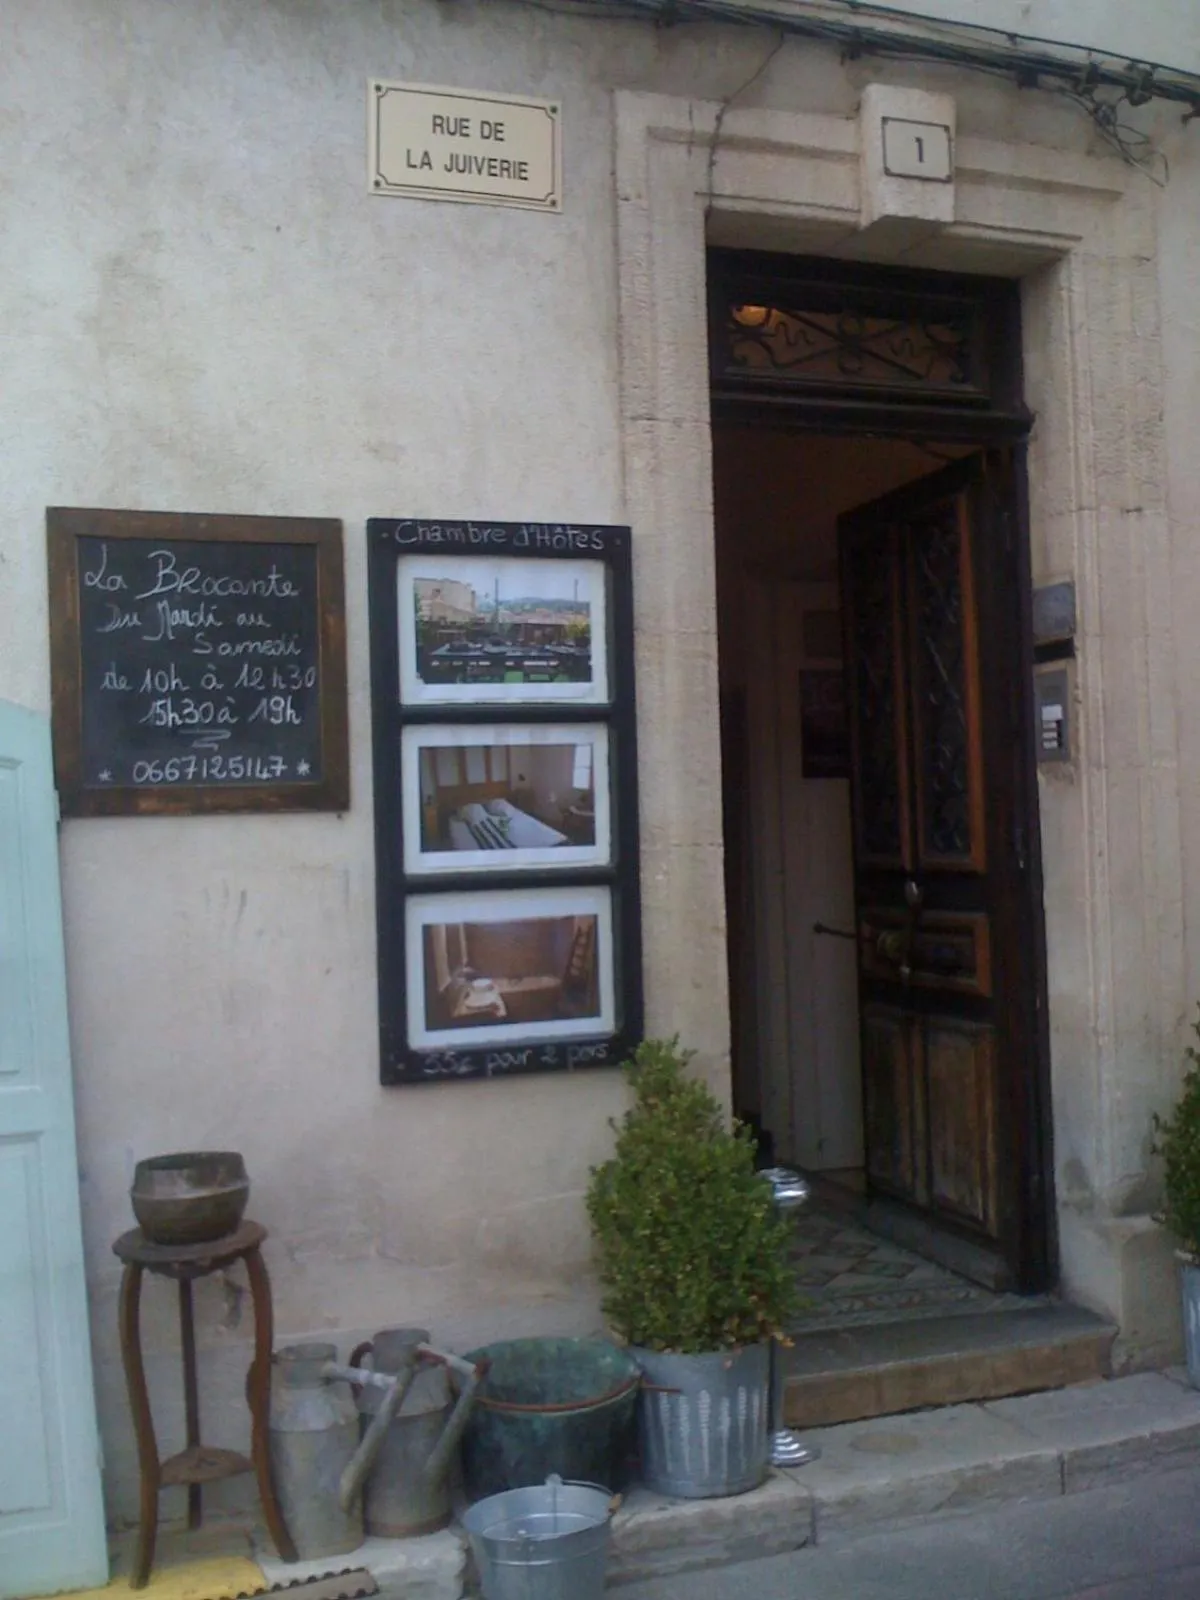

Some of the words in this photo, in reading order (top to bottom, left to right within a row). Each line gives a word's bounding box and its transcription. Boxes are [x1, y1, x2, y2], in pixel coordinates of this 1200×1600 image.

[431, 114, 470, 138] RUE
[480, 121, 505, 141] DE
[913, 135, 925, 164] 1
[405, 149, 433, 171] LA
[444, 154, 529, 181] JUIVERIE
[395, 522, 507, 545] Chambre
[84, 544, 128, 591] La
[192, 633, 301, 656] Samedi
[101, 661, 133, 692] de
[139, 663, 189, 693] 10h
[248, 696, 301, 725] 19h
